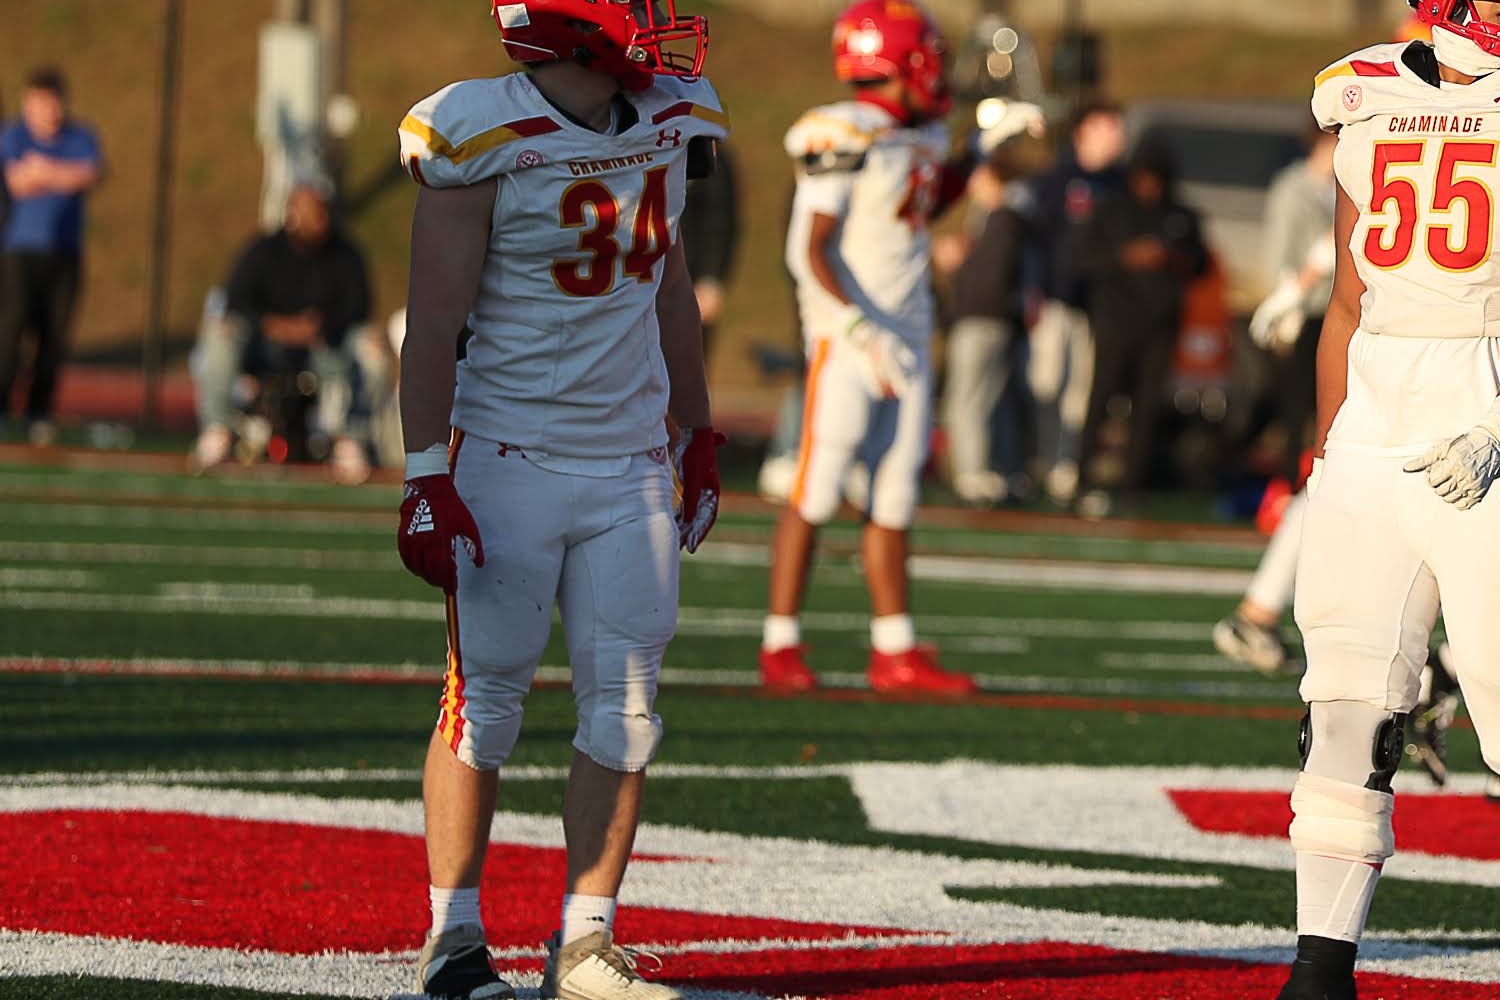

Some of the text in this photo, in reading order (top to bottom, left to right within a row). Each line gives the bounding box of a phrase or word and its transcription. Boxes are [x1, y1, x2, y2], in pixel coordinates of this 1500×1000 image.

[1388, 115, 1483, 133] CHAMINADE
[568, 152, 653, 176] CHAMINADE
[551, 164, 676, 298] 34
[1362, 139, 1500, 272] 55
